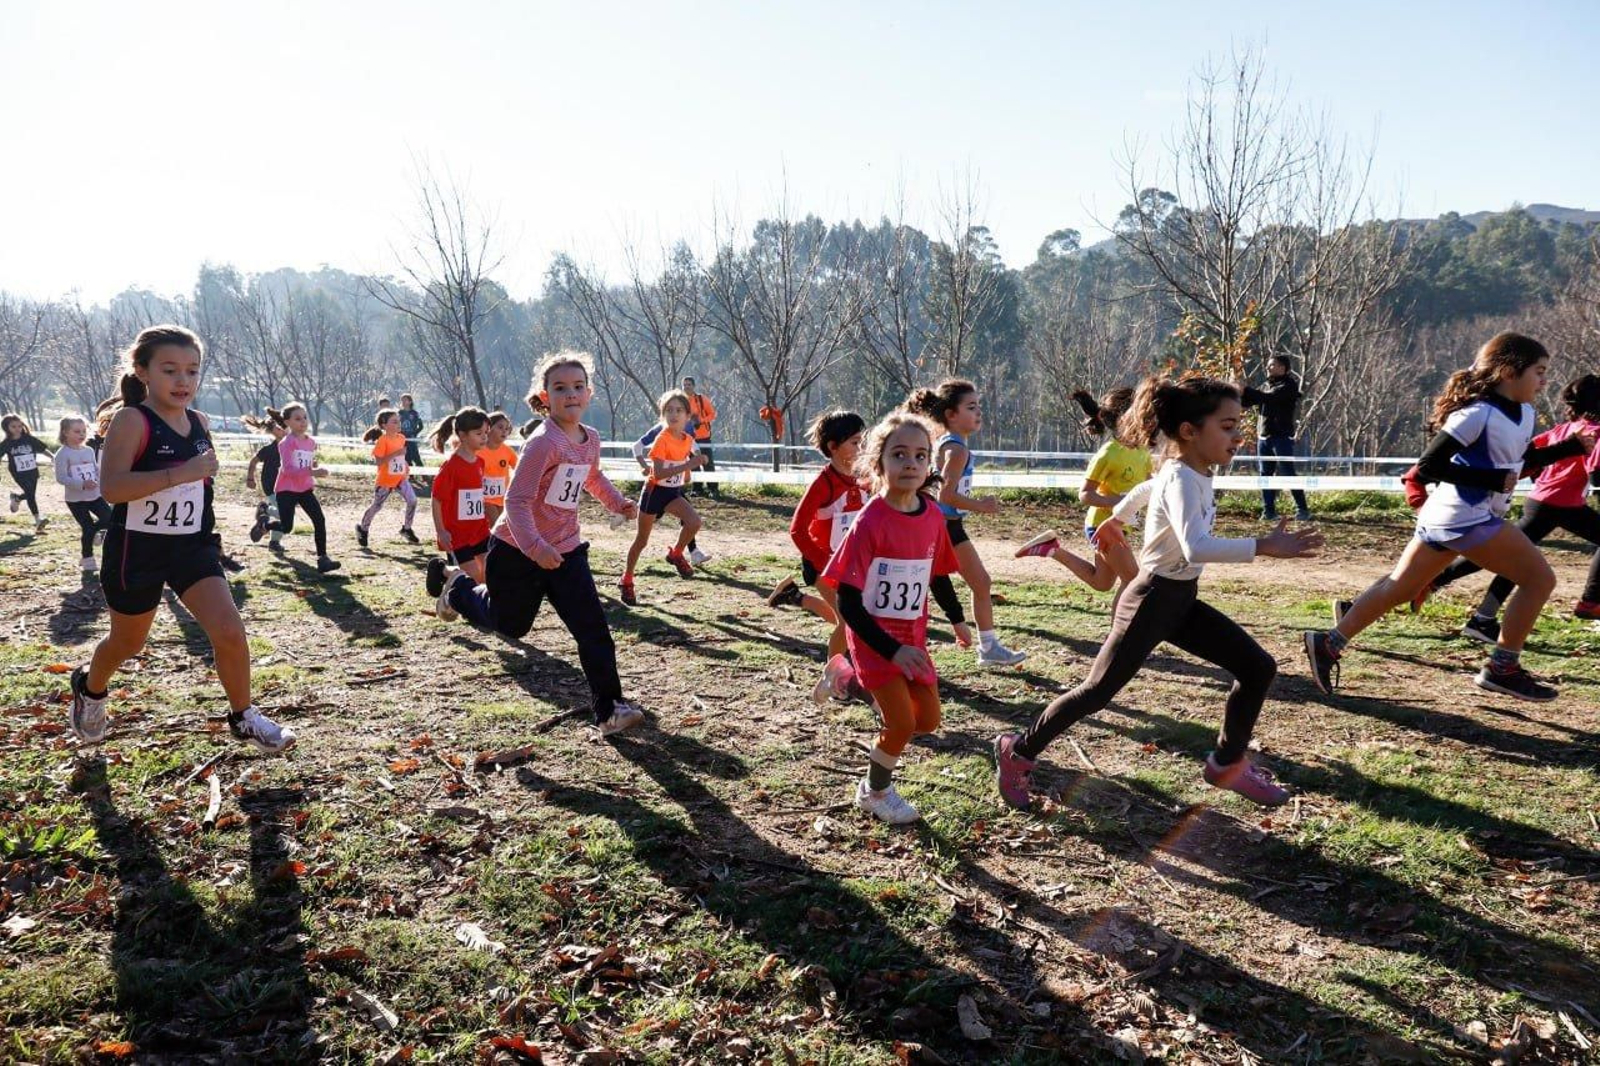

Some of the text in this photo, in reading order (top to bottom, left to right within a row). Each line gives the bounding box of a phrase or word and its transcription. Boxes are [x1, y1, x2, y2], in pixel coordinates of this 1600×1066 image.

[483, 485, 501, 496] 261
[144, 500, 195, 527] 242
[875, 580, 922, 611] 332
